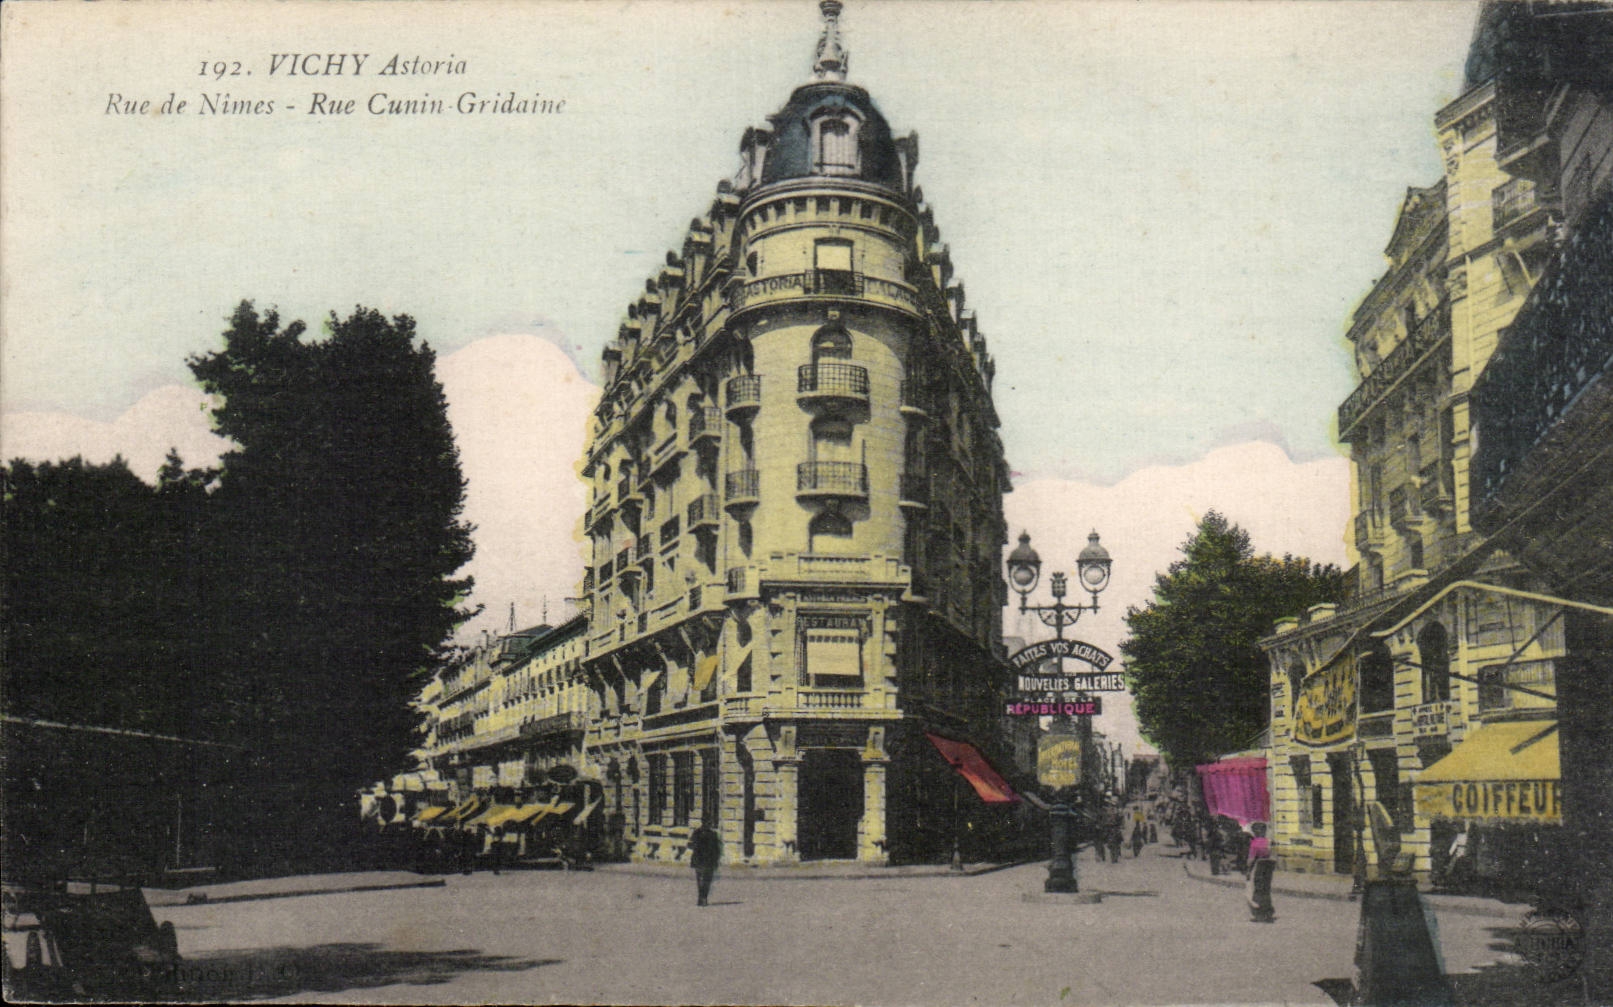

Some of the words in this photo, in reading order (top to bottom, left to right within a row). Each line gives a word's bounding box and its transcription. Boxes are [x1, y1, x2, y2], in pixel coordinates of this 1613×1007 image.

[1012, 645, 1048, 668] FAITES
[1050, 642, 1069, 654] VOS
[1072, 644, 1110, 668] ACHATS
[1074, 674, 1125, 691] GALERIES
